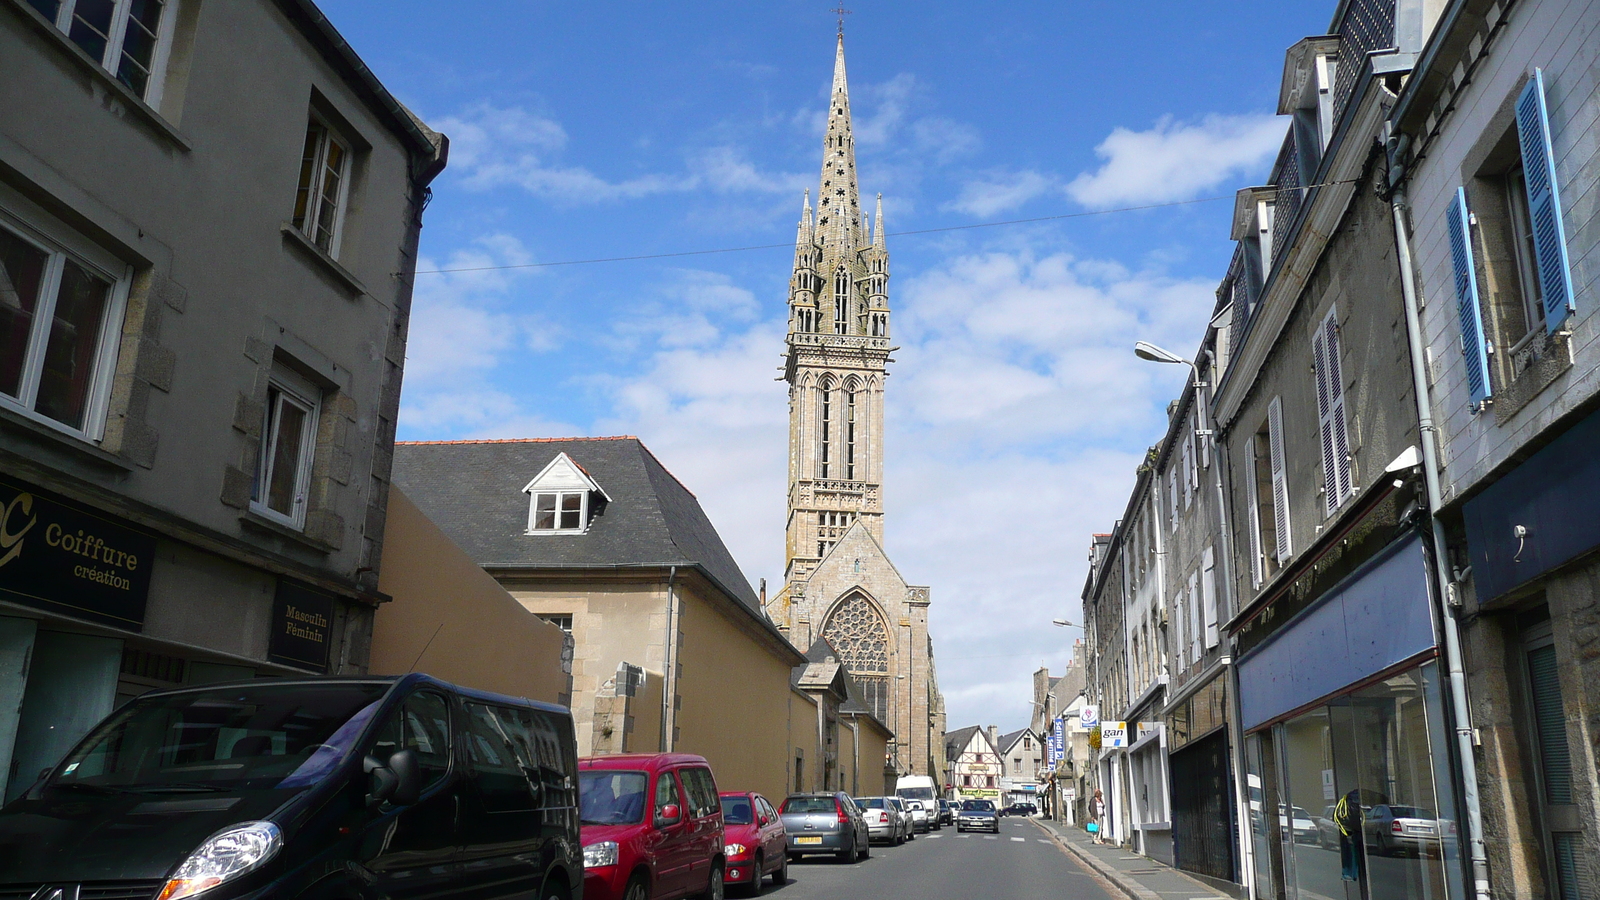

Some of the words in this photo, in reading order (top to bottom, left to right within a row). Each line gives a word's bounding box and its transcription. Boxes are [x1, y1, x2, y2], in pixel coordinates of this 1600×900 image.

[46, 523, 138, 571] Coiffure
[74, 565, 130, 590] création
[286, 605, 327, 627] Masculin
[286, 622, 323, 643] Féminin
[1055, 721, 1063, 749] PHILIPS
[1103, 729, 1124, 739] gan
